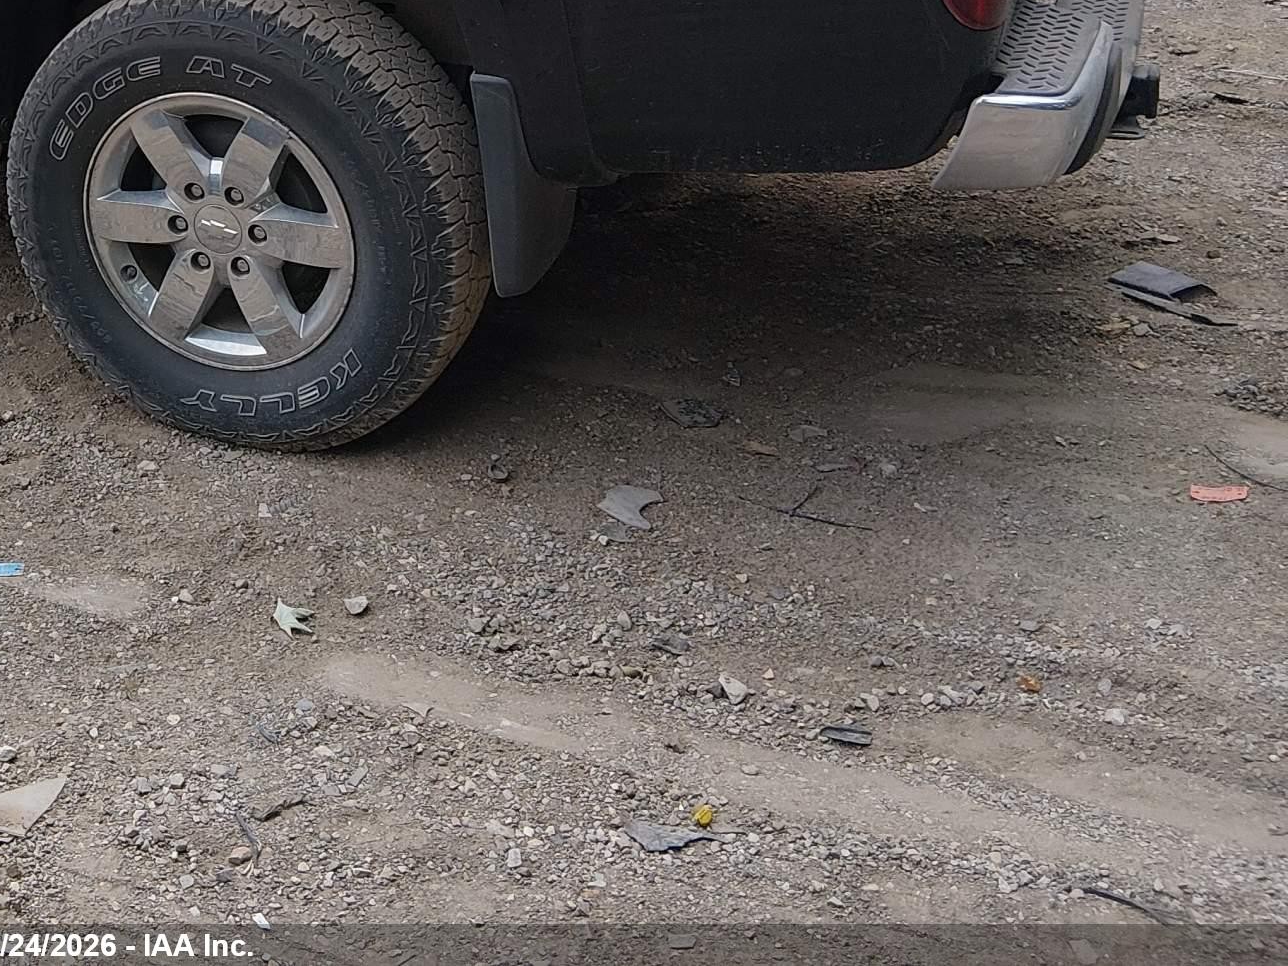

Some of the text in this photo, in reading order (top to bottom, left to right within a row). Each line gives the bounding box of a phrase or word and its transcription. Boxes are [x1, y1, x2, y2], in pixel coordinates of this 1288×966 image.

[49, 55, 272, 161] EDGE AT
[179, 347, 363, 417] KELLY
